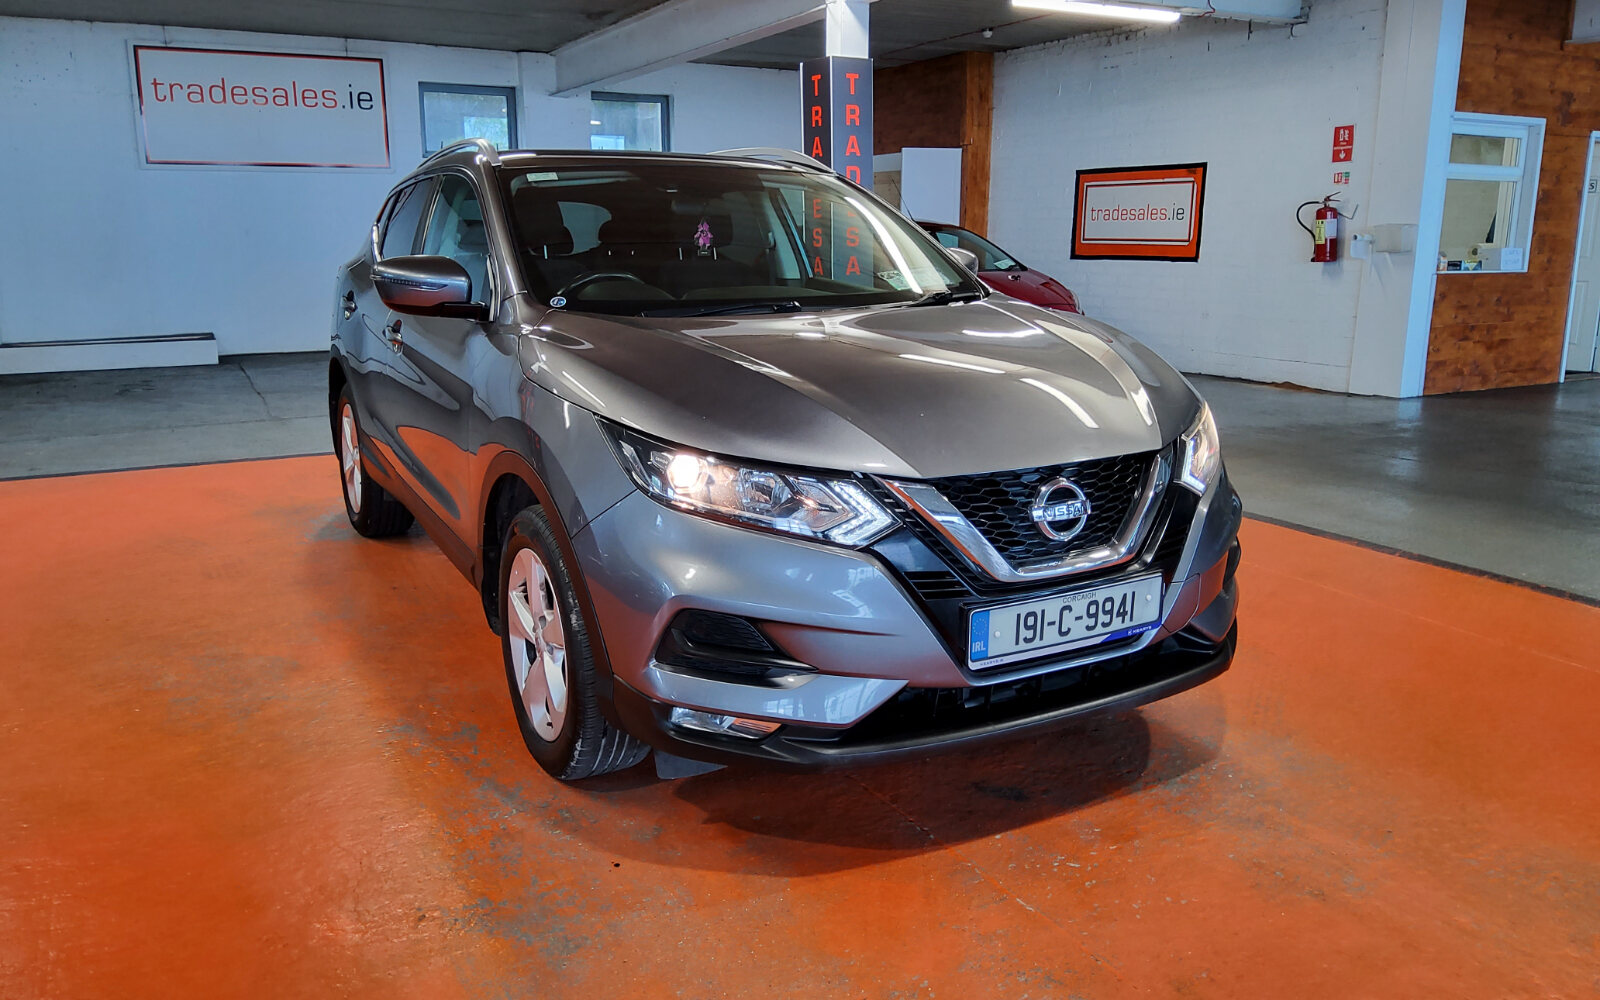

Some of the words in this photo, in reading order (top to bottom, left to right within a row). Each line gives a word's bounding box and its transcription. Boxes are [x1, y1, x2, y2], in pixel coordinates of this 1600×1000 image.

[150, 77, 374, 111] tradesales.ie
[1090, 202, 1185, 221] tradesales.ie
[1043, 502, 1087, 518] NISSAN
[1062, 592, 1097, 603] CORCAIGH
[1014, 590, 1136, 646] 191-C-9941
[972, 640, 986, 653] IRL
